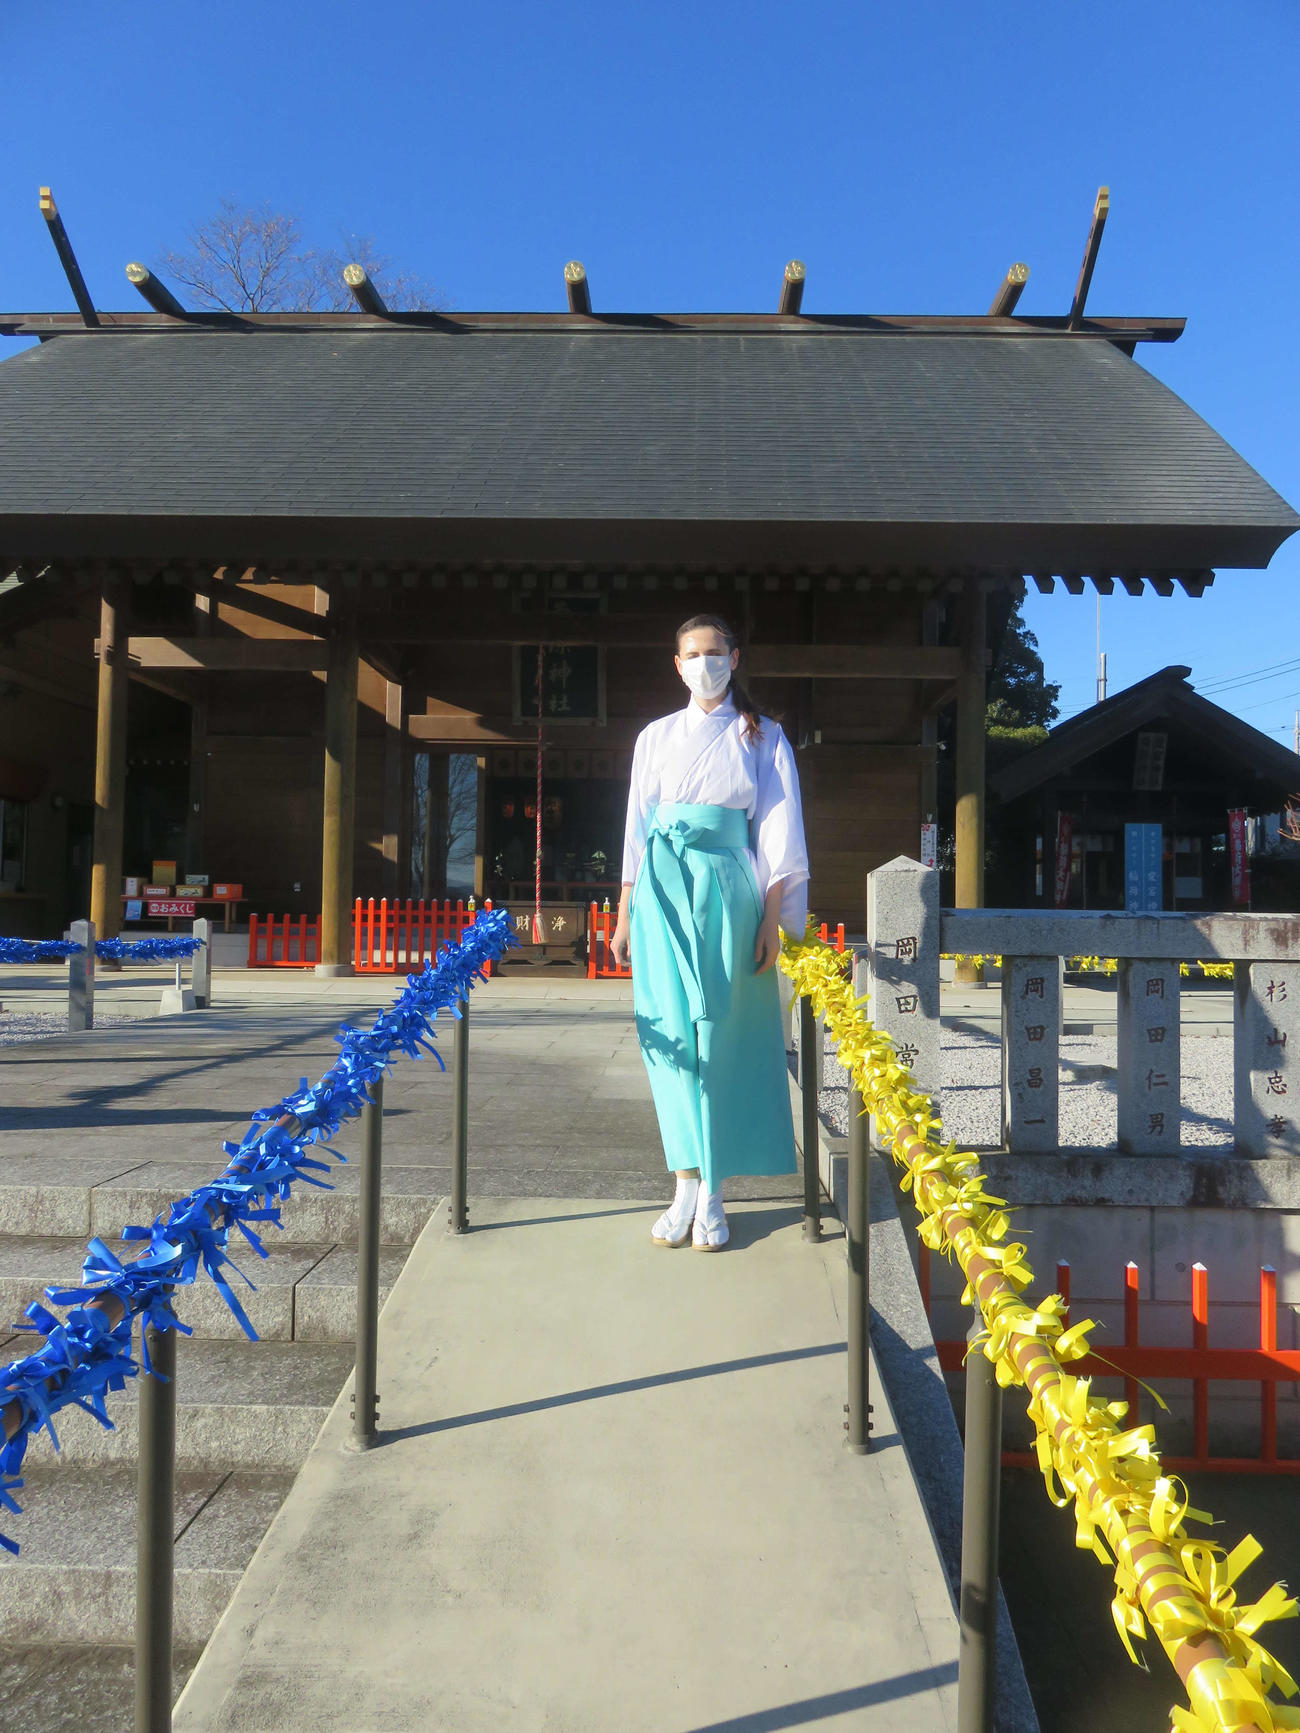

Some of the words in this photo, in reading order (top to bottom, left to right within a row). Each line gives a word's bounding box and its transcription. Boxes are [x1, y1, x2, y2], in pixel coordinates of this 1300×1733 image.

[1024, 977, 1046, 1125] 岡田昌一
[1145, 977, 1169, 1136] 岡田仁男
[1266, 979, 1289, 1139] 杉山忠孝
